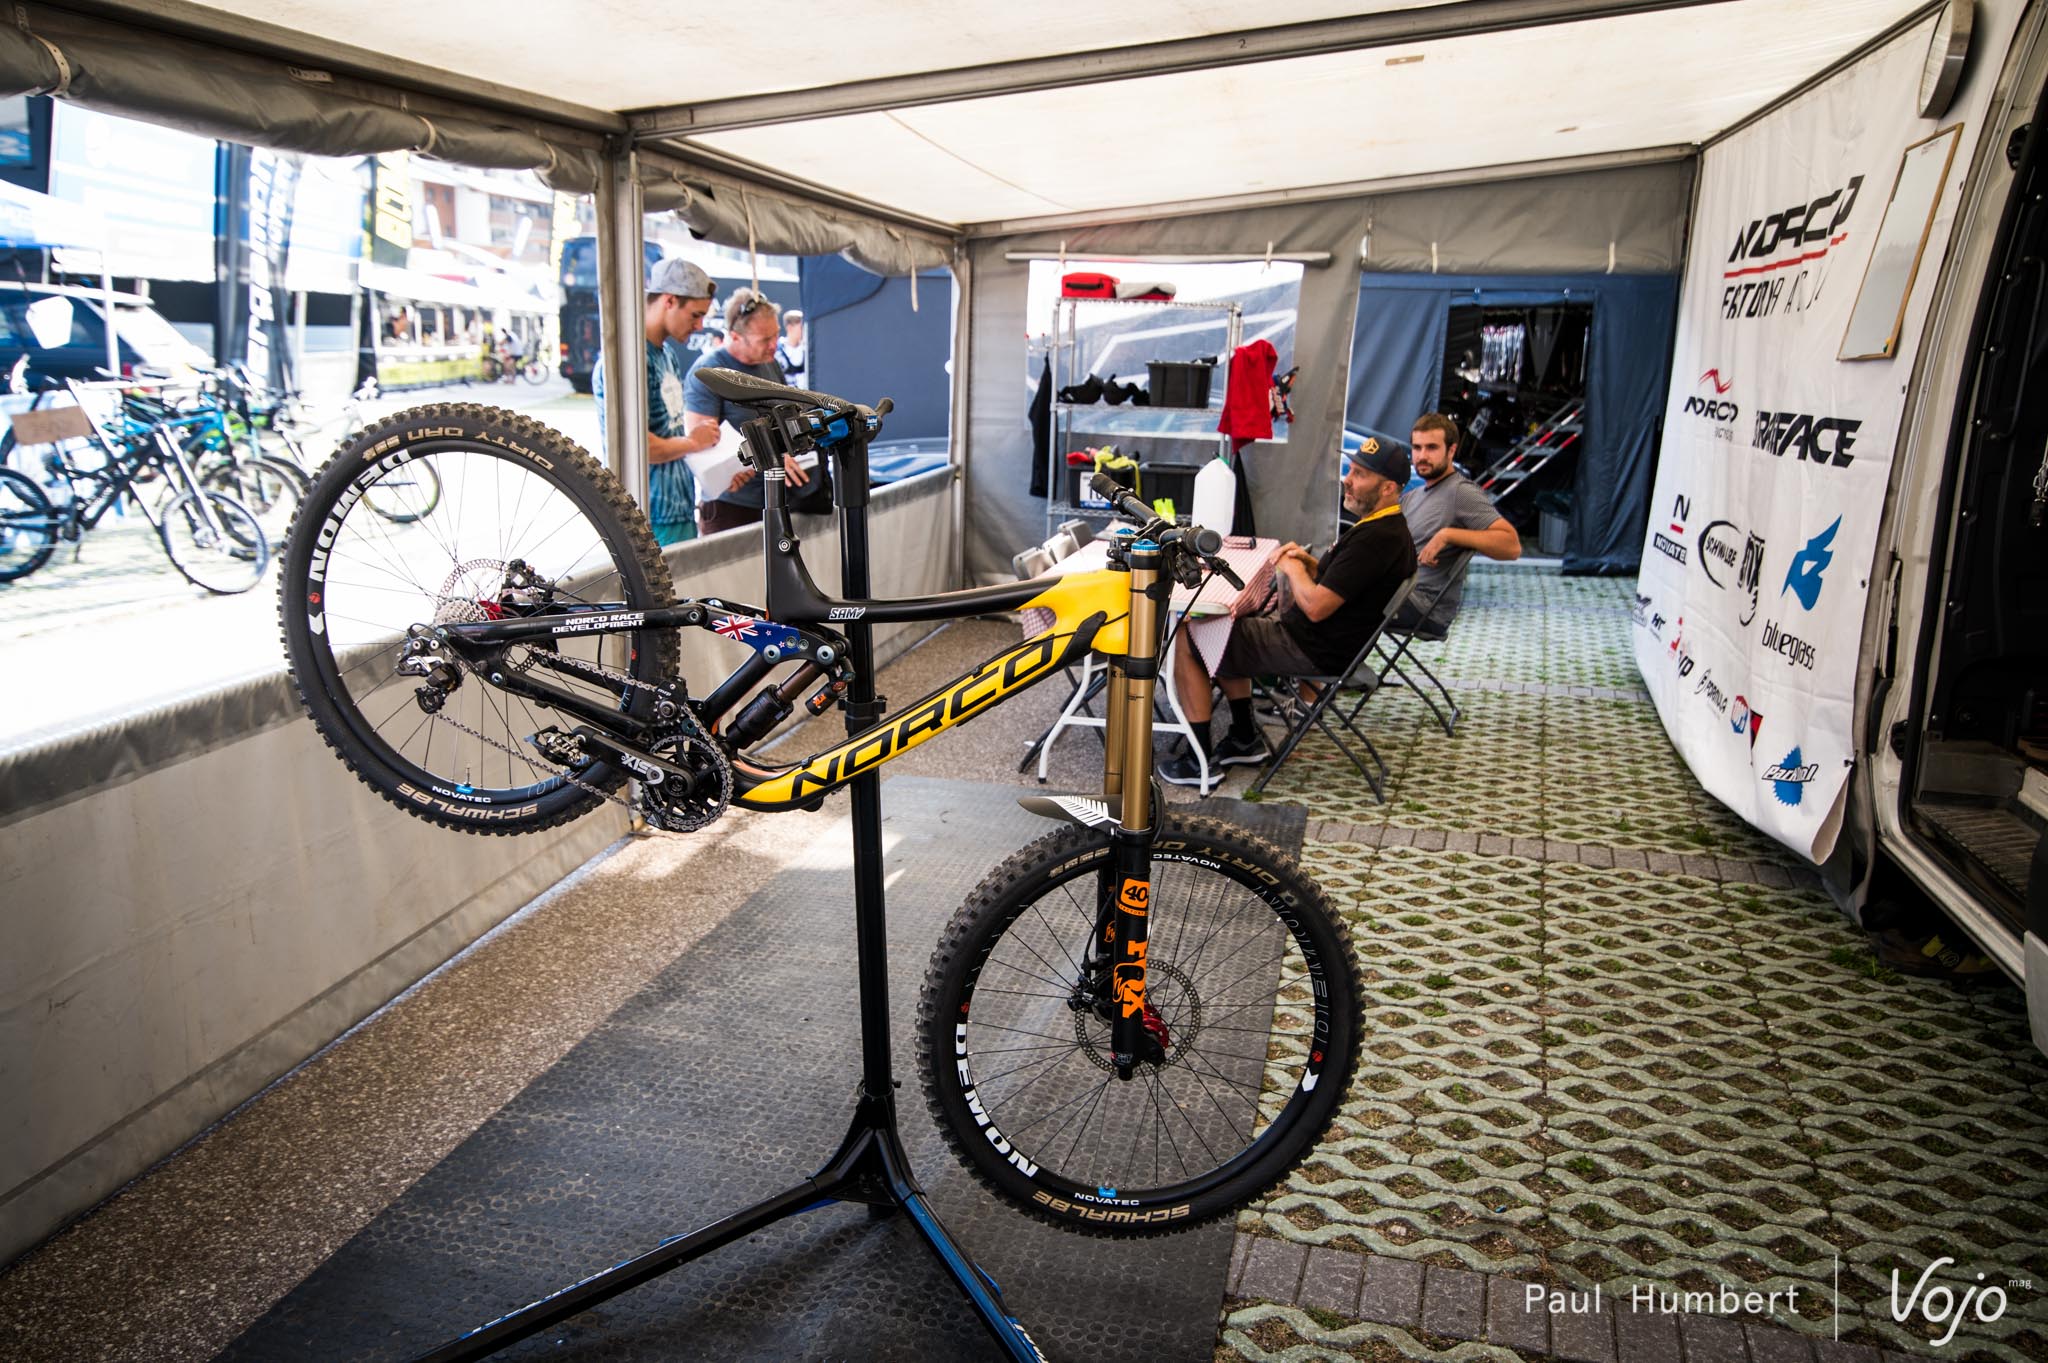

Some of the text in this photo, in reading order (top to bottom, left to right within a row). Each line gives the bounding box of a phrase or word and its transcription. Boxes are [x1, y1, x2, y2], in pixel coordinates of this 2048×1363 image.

[1728, 174, 1865, 263] NORCO
[475, 432, 554, 470] DIRTY
[308, 449, 412, 582] DEMON
[552, 620, 645, 633] DEVELOPMENT
[566, 613, 645, 625] NORCO RACE
[1762, 619, 1816, 671] bluegrass
[790, 634, 1054, 800] NORCO
[396, 783, 538, 820] SCHWALBE
[432, 786, 491, 803] NOVATEC
[1153, 853, 1221, 869] NOVATEC
[1124, 886, 1149, 902] 40
[956, 1023, 1039, 1178] DEMON
[1032, 1190, 1190, 1223] SCHWALBE
[1074, 1192, 1140, 1206] NOVATEC
